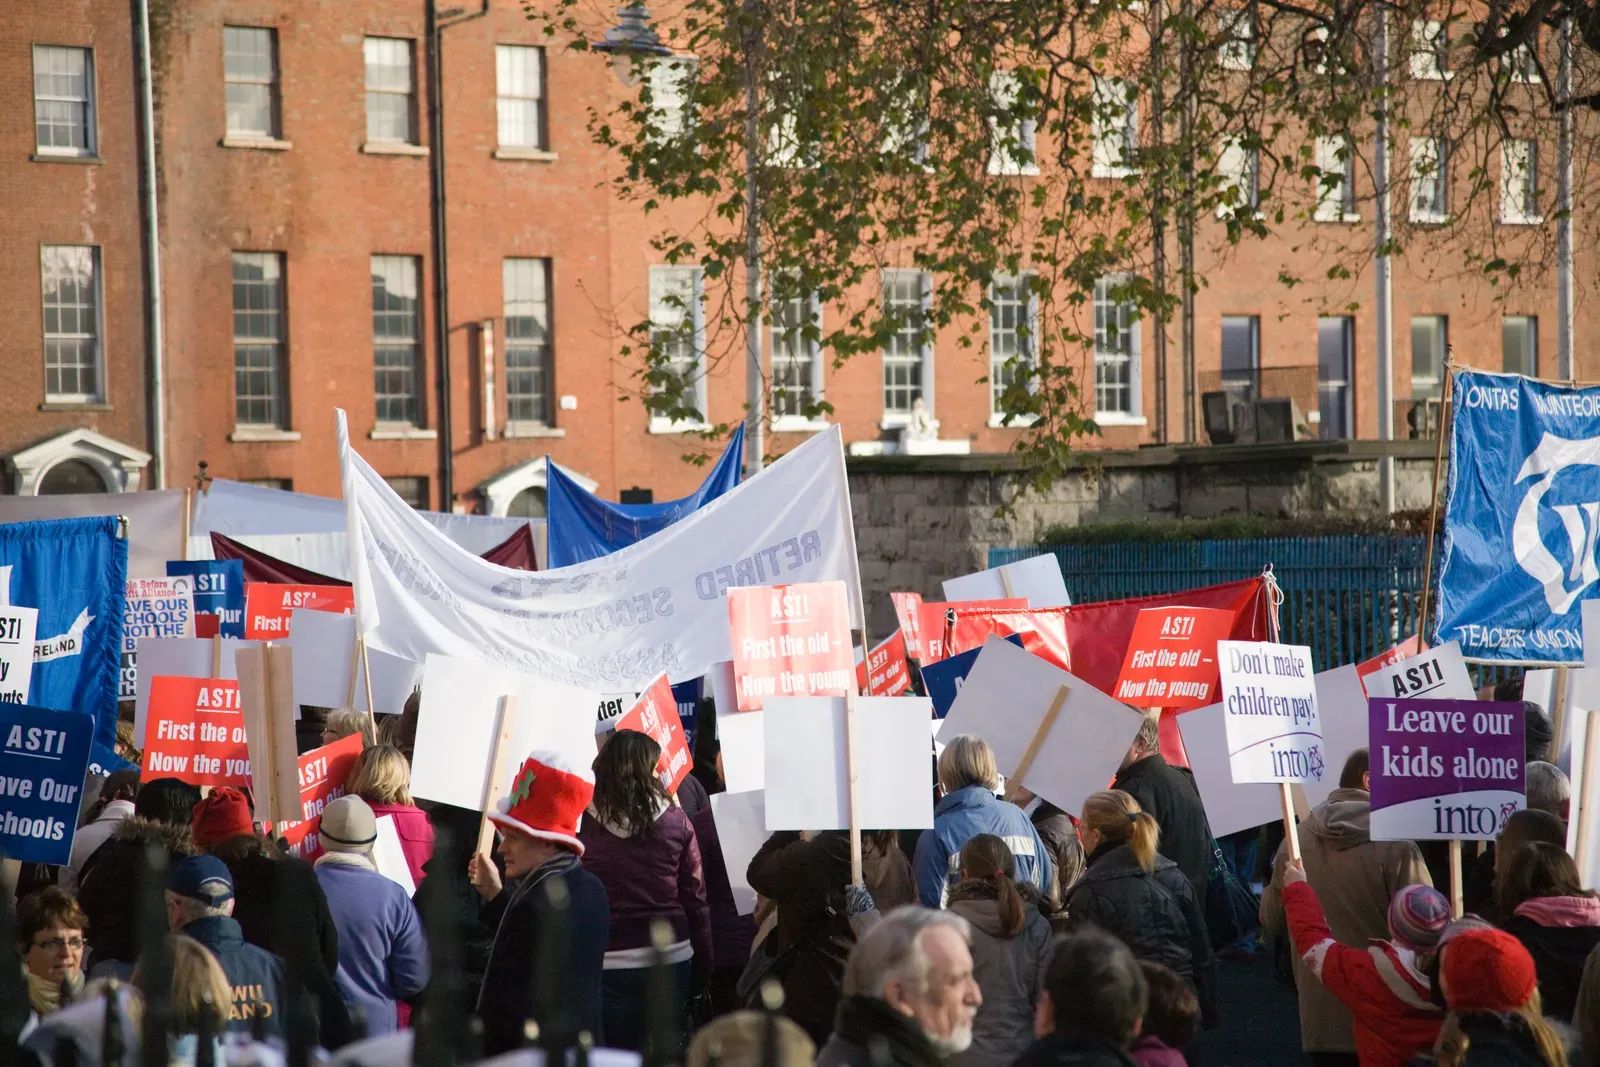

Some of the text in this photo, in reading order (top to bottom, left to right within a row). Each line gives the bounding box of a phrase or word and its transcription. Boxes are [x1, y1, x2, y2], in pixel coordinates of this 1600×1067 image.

[1466, 386, 1519, 410] ONTAS
[140, 580, 168, 588] Before
[141, 588, 176, 598] Alliance
[193, 573, 226, 591] STI
[155, 599, 188, 611] OUR
[772, 593, 809, 618] ASTI
[121, 623, 184, 637] NOT THE
[254, 615, 282, 631] First
[1161, 616, 1195, 635] ASTI
[743, 637, 776, 660] First
[780, 634, 805, 656] the
[808, 632, 830, 654] old
[1131, 650, 1157, 668] First
[1156, 648, 1178, 667] the
[1179, 649, 1201, 667] old
[1228, 647, 1306, 678] Don't make
[886, 664, 900, 678] old
[1392, 659, 1444, 698] ASTI
[742, 669, 851, 697] Now the young
[1118, 679, 1209, 700] Now the young
[197, 687, 241, 708] ASTI
[1228, 686, 1316, 726] children pay!
[678, 701, 695, 717] ur
[1386, 703, 1514, 735] Leave our
[6, 725, 66, 754] ASTI
[158, 720, 195, 741] First
[200, 722, 227, 743] the
[149, 752, 188, 772] Now
[193, 754, 220, 774] the
[1269, 743, 1309, 779] into
[1381, 745, 1519, 780] kids alone
[39, 778, 78, 804] Our
[303, 798, 324, 820] the
[1433, 798, 1497, 835] into
